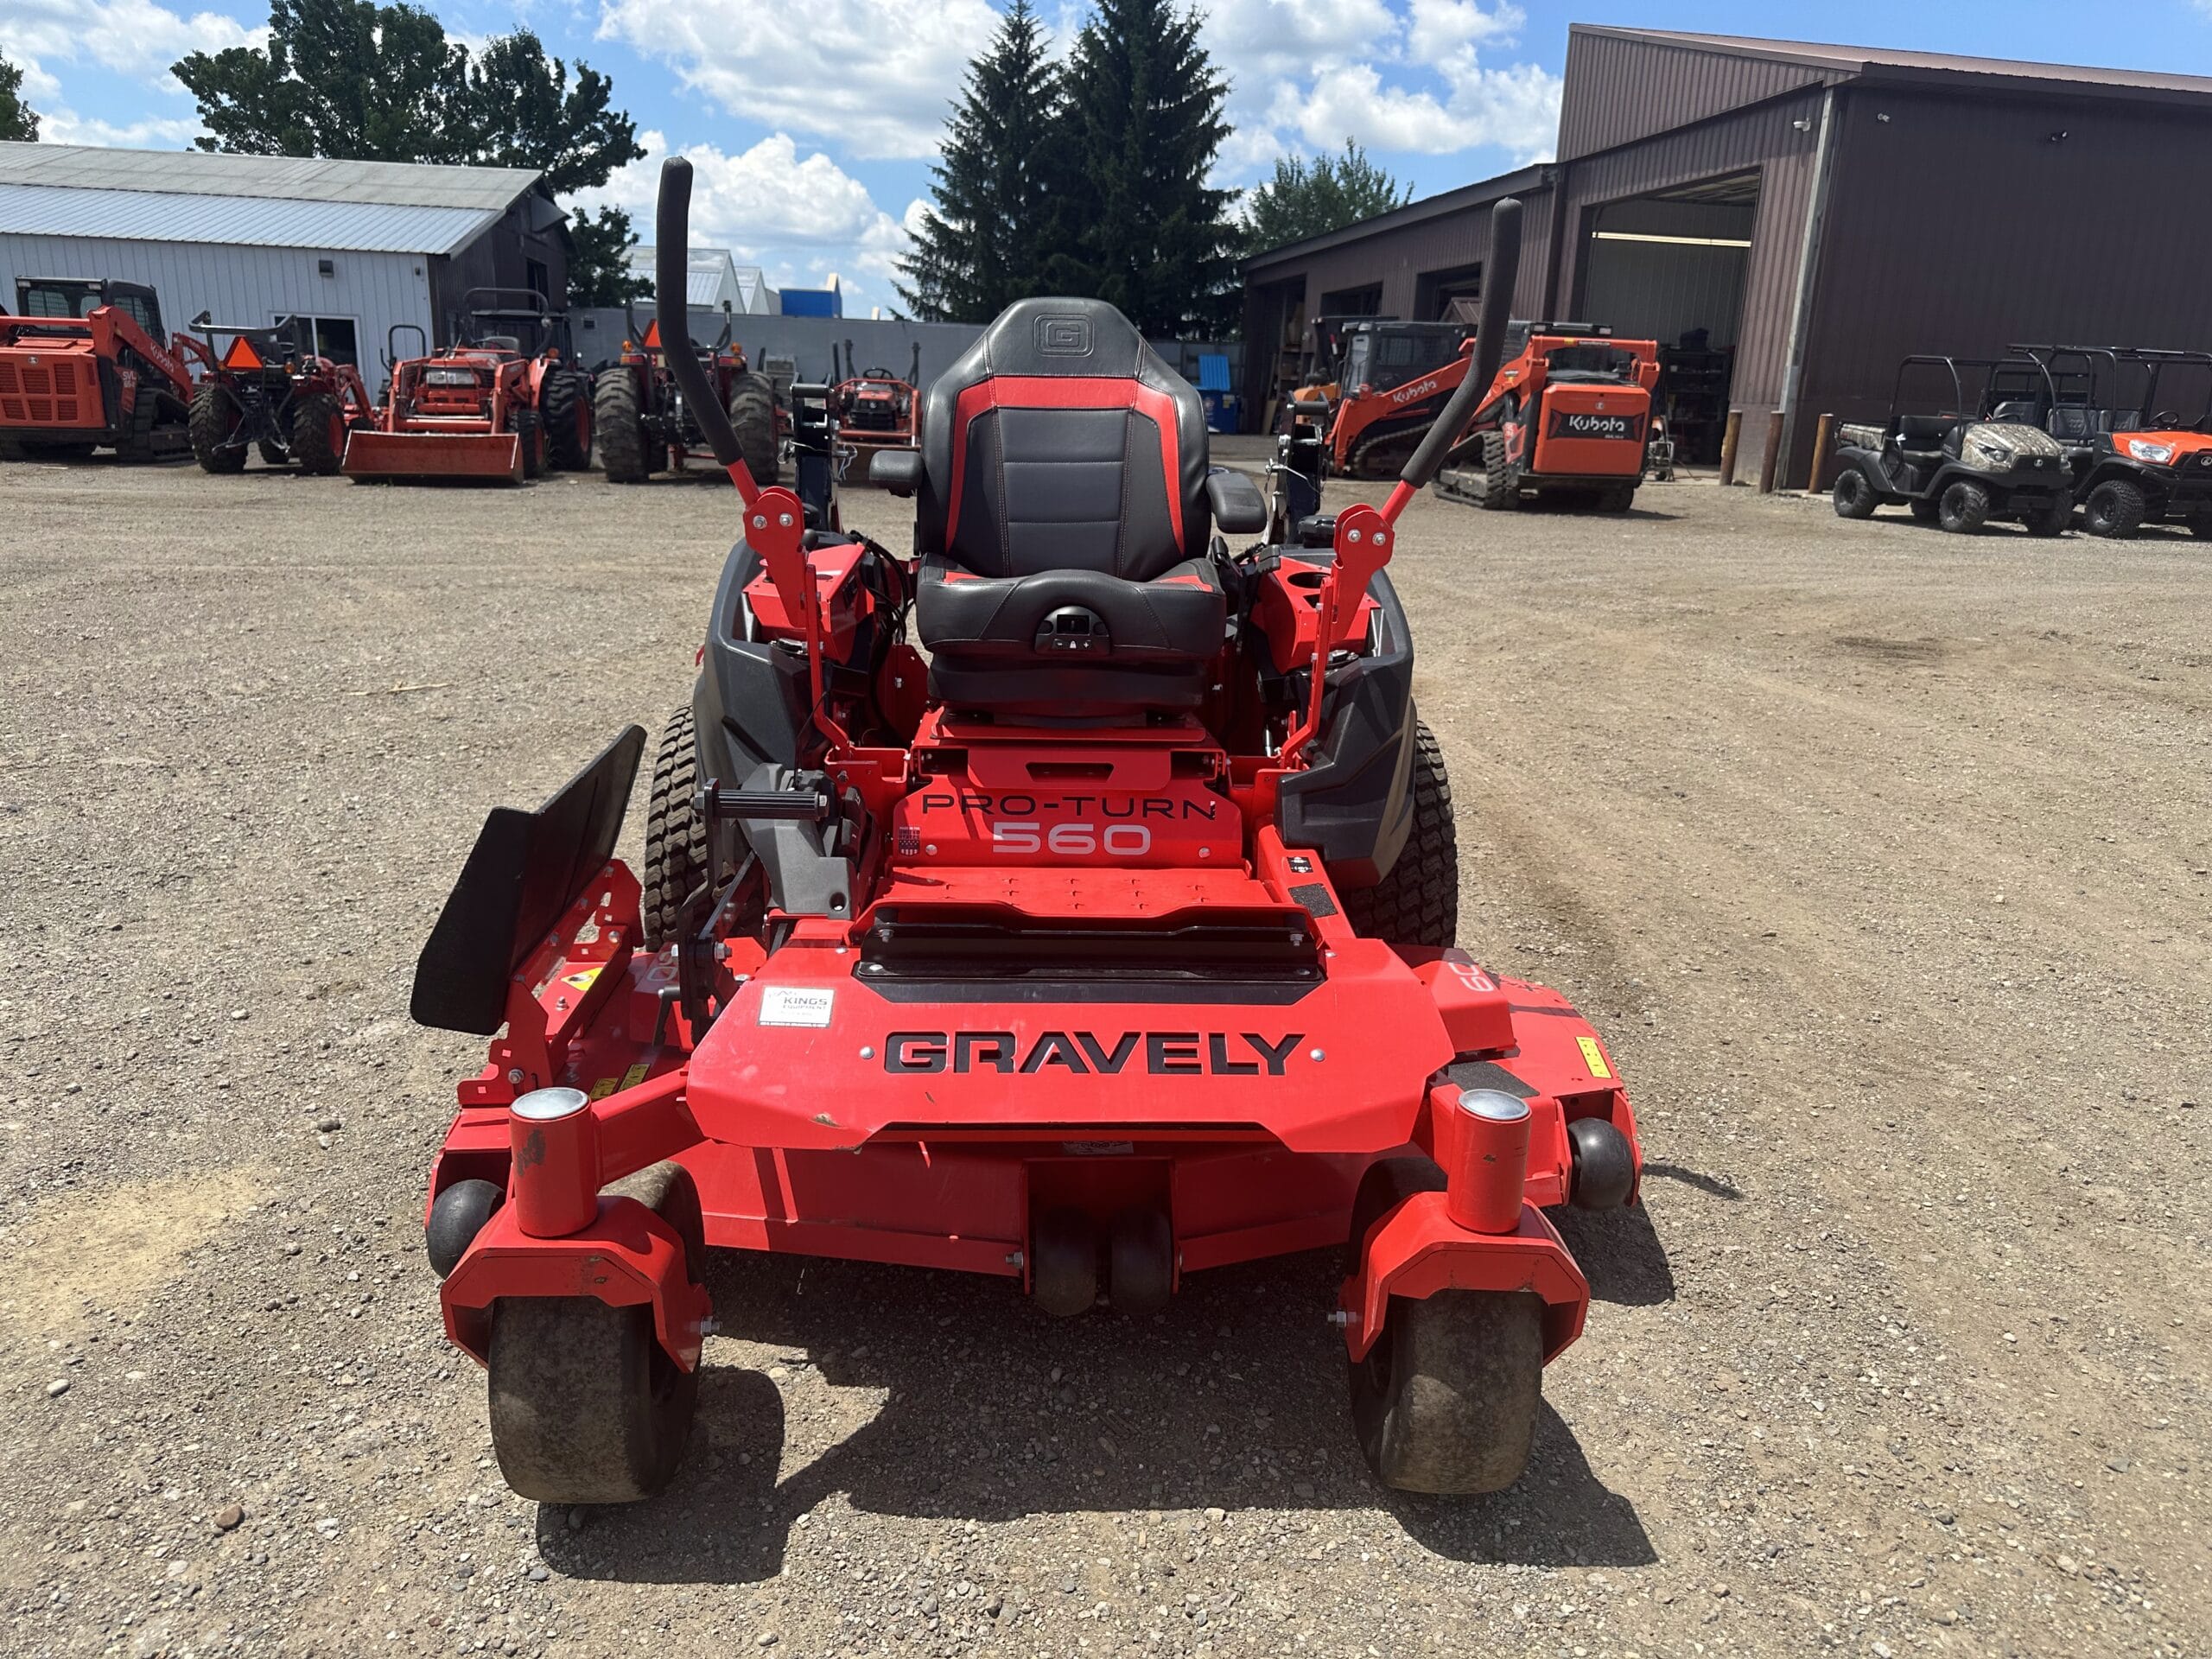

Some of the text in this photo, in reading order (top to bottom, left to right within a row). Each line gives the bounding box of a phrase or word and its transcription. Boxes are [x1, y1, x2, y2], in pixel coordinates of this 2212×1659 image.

[123, 371, 137, 381] SVL
[1392, 380, 1437, 403] Kubota
[1568, 416, 1624, 431] Kubota
[922, 794, 1216, 820] PRO-TURN
[993, 822, 1151, 855] 560
[784, 996, 828, 1006] KINGS
[884, 1031, 1306, 1077] GRAVELY
